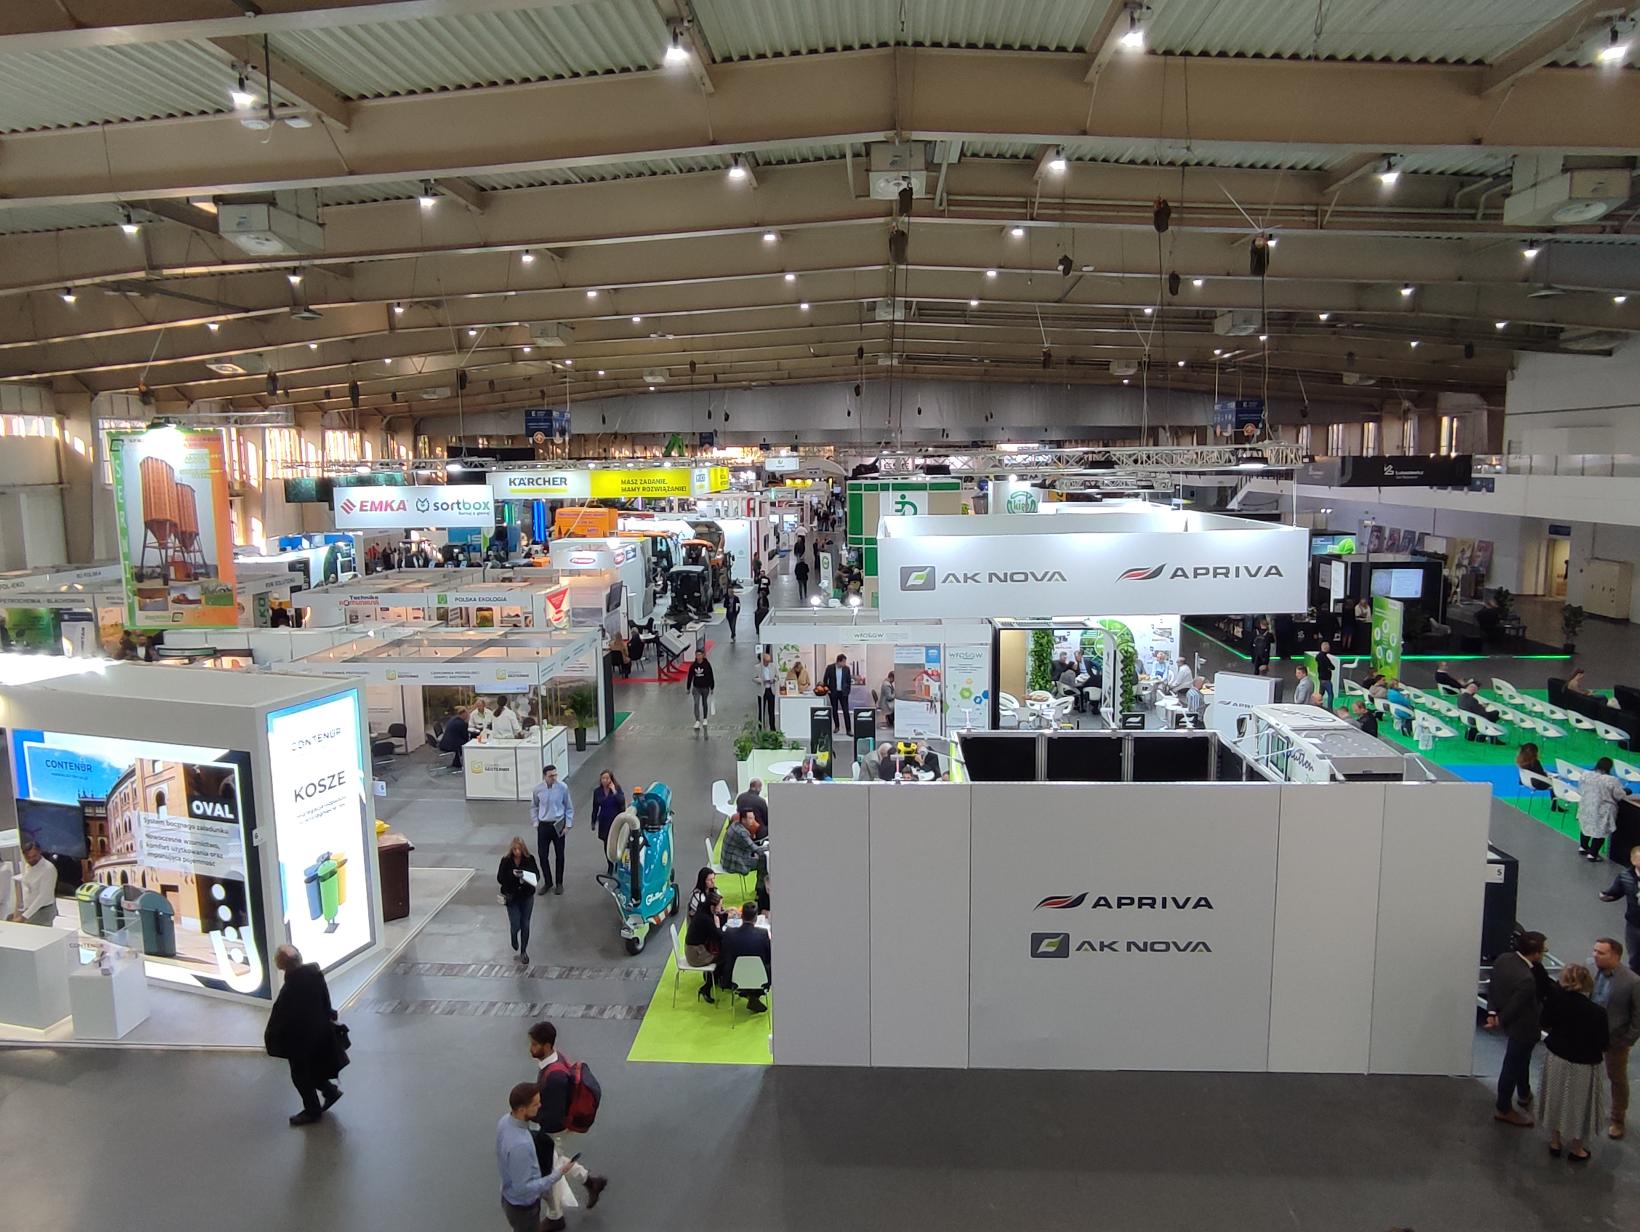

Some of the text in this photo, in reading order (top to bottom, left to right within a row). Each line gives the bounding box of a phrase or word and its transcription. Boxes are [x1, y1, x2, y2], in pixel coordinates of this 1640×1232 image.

[508, 475, 567, 487] KÄRCHER
[358, 498, 490, 512] EMKA sortbox
[941, 570, 1067, 584] AK NOVA
[1169, 564, 1284, 580] APRIVA
[45, 759, 93, 773] CONTENUR
[294, 770, 346, 803] KOSZE
[191, 800, 235, 819] OVAL
[1091, 896, 1214, 909] APRIVA
[1075, 940, 1212, 952] AK NOVA
